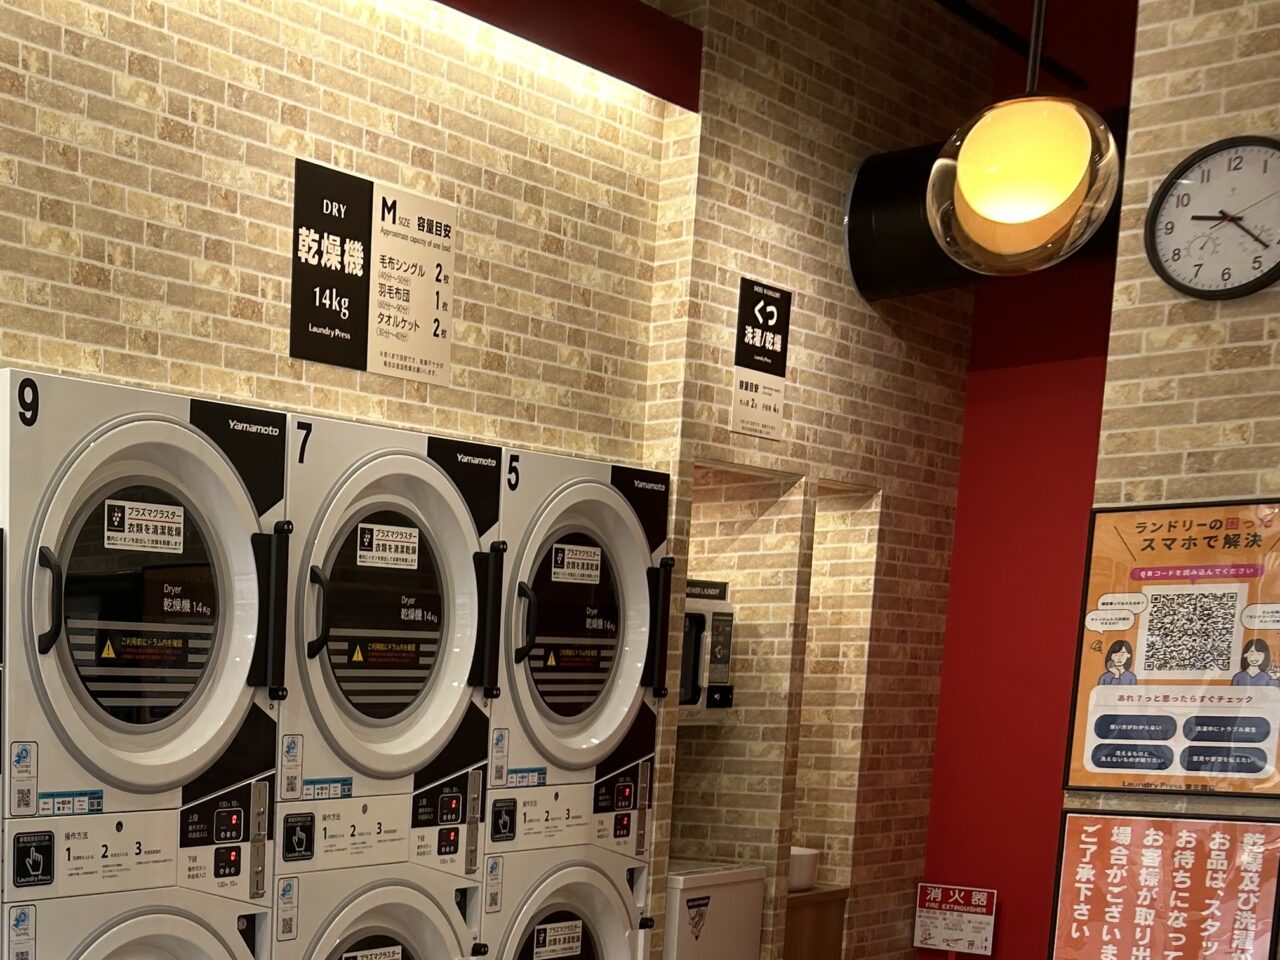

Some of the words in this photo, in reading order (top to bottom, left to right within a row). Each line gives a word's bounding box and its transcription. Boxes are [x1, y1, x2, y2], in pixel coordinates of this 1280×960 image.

[1227, 156, 1244, 172] 12
[1262, 159, 1268, 174] 1
[1200, 169, 1211, 184] 11
[322, 199, 347, 219] DRY
[1176, 192, 1191, 209] 10
[381, 195, 397, 225] M
[417, 216, 452, 239] 容量目安
[1164, 221, 1175, 235] 9
[297, 226, 364, 277] 乾燥機
[1172, 248, 1181, 262] 8
[380, 254, 426, 278] 毛布シングル
[1193, 263, 1203, 278] 7
[1252, 255, 1262, 270] 5
[1221, 267, 1231, 281] 6
[378, 282, 410, 303] 羽毛布団
[313, 286, 350, 320] 14kg
[377, 312, 420, 332] タオルケット
[754, 300, 777, 326] くつ
[308, 322, 334, 340] Laundry
[334, 328, 351, 340] Press
[18, 377, 39, 427] 9
[228, 419, 279, 437] Yamamoto
[296, 421, 313, 464] 7
[456, 453, 497, 467] Yamamoto
[507, 454, 520, 491] 5
[128, 506, 182, 520] プラズマクラスター
[127, 522, 182, 537] 衣類を清潔乾燥
[1140, 532, 1263, 551] スマホで解決
[163, 583, 182, 595] Dryer
[1071, 824, 1102, 939] ご了承下さい
[926, 887, 988, 906] 消火器
